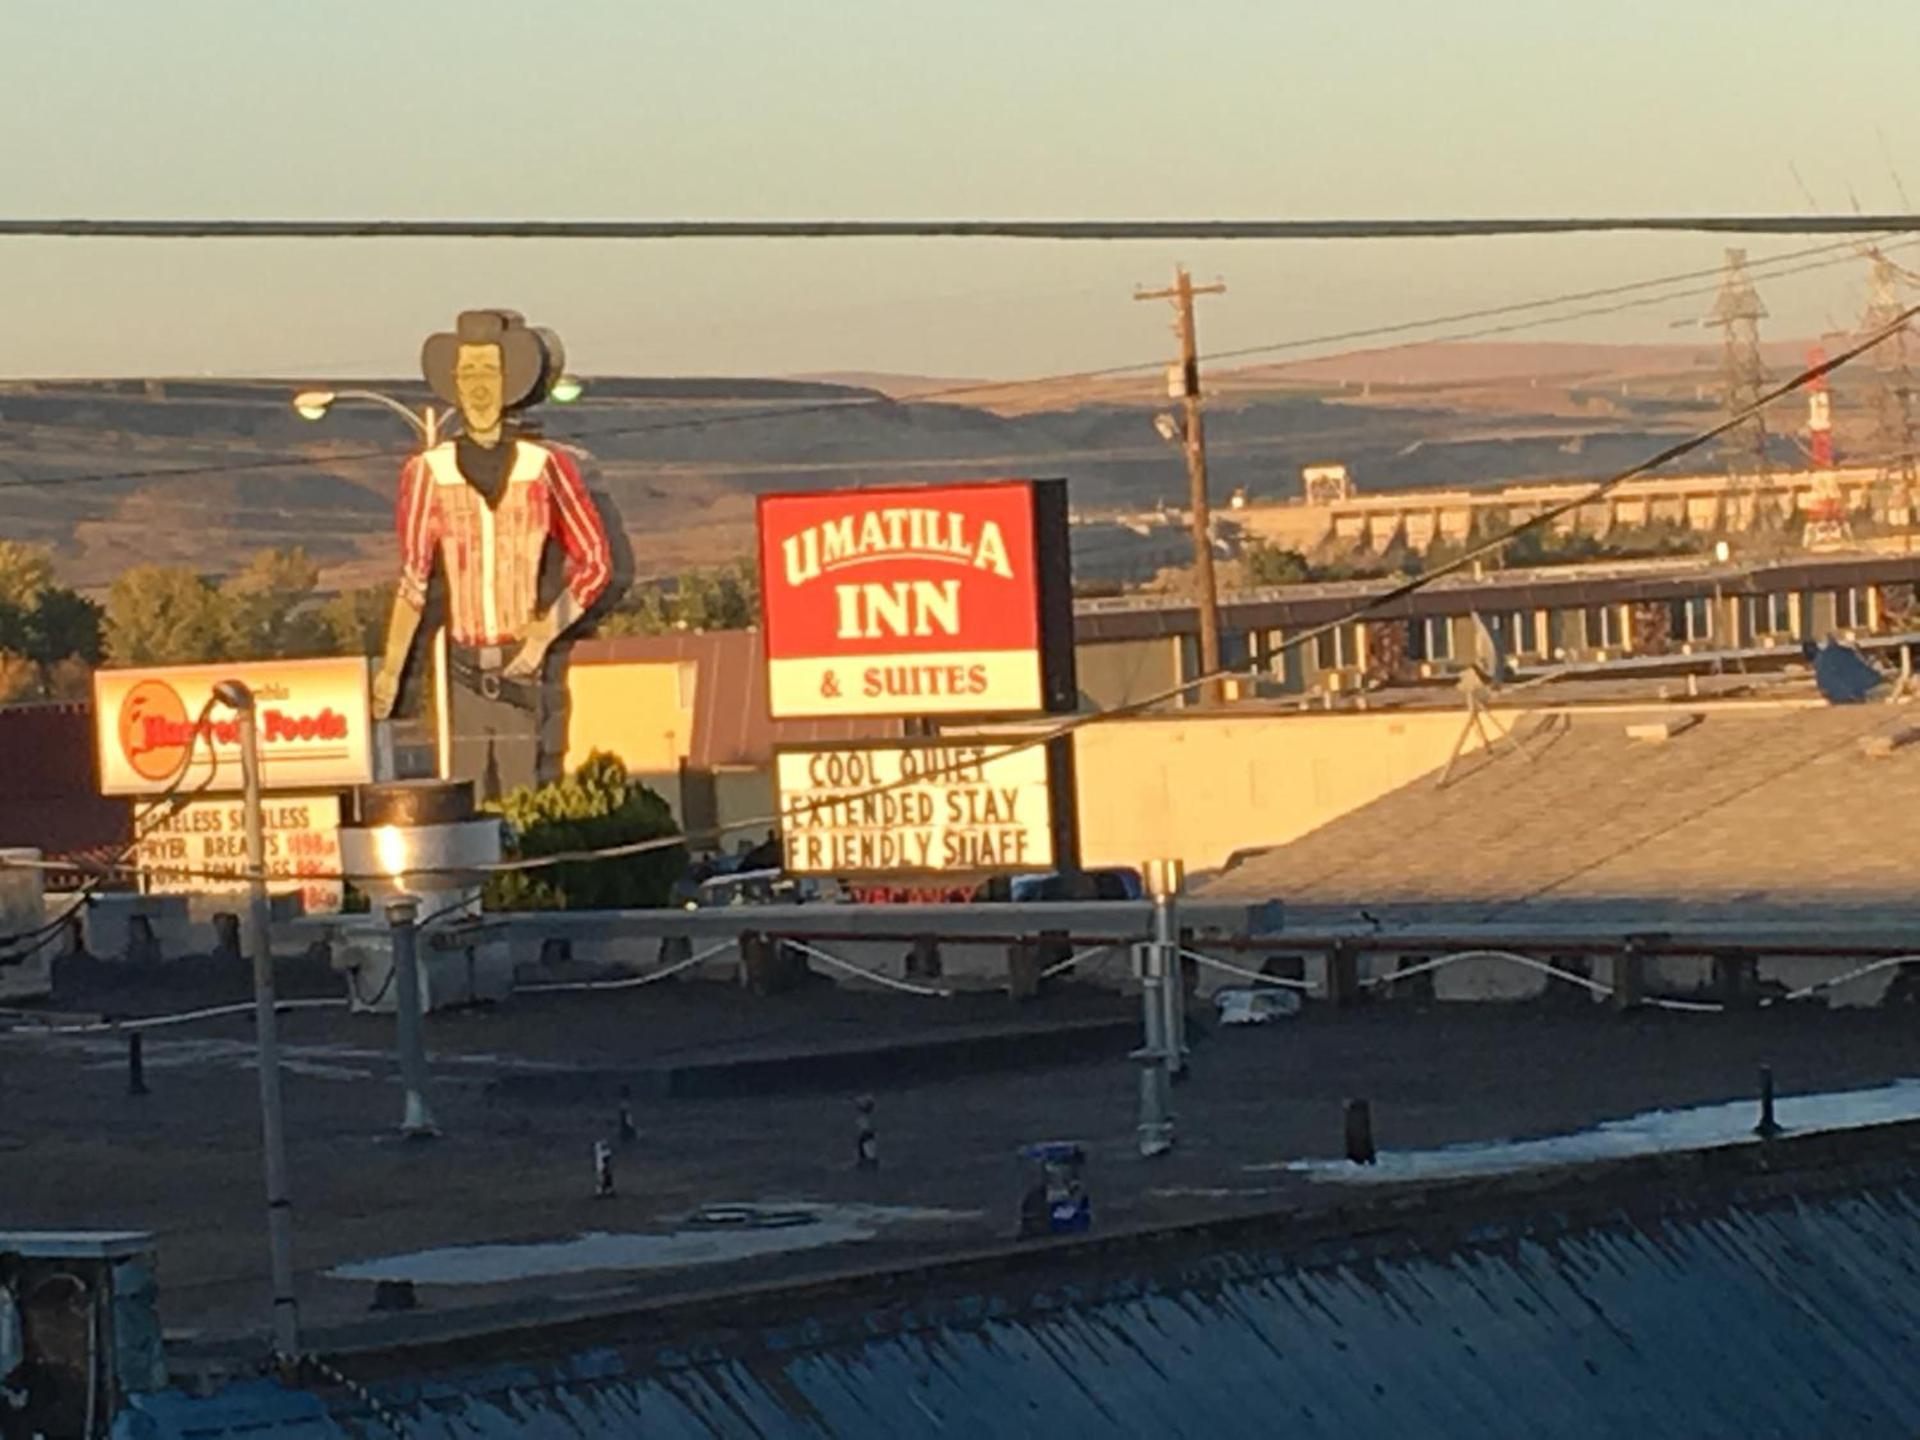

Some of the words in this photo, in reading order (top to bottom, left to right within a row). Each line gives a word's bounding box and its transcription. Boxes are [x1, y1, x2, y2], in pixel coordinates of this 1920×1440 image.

[782, 508, 1014, 586] UMATILLA
[835, 580, 961, 639] INN
[820, 670, 842, 698] &
[863, 665, 987, 697] SUITES
[263, 708, 348, 742] Foods
[808, 751, 881, 788] COOL
[900, 747, 988, 784] QUIET
[790, 792, 934, 828] EXTENDED
[946, 787, 1018, 824] STAY
[786, 832, 932, 869] FRIENDLY
